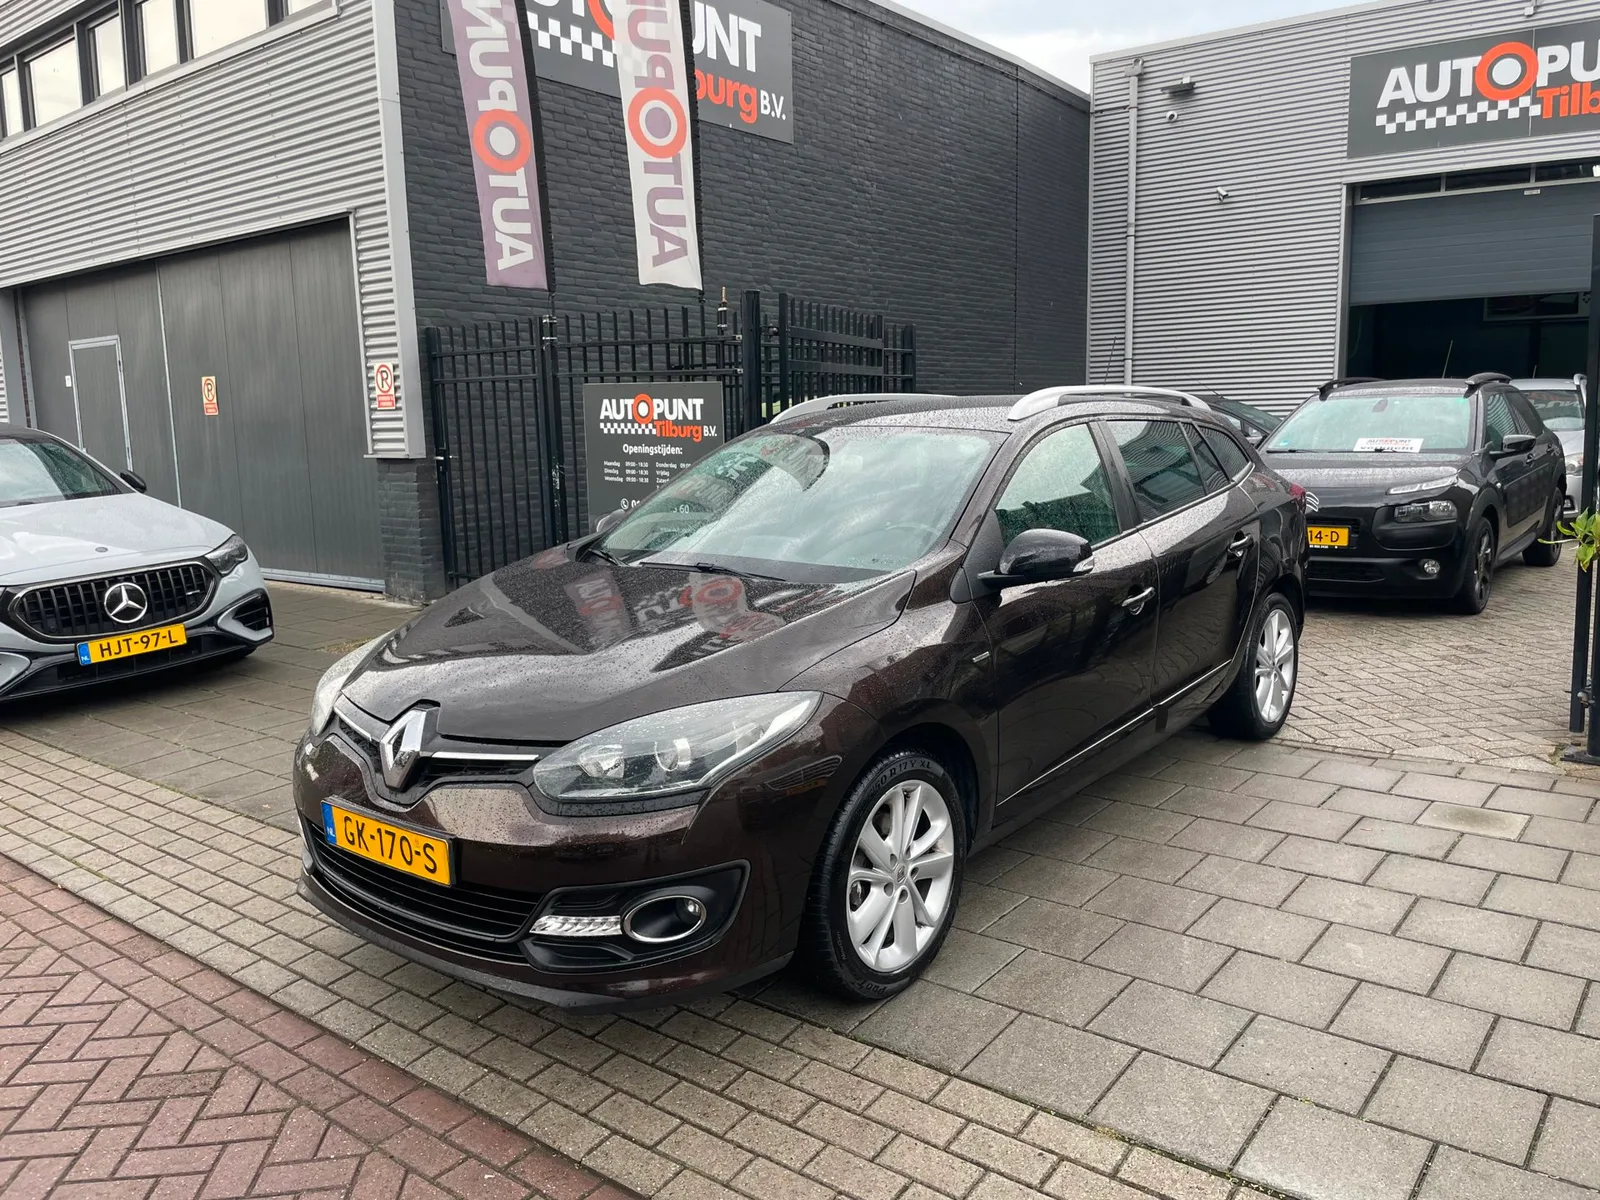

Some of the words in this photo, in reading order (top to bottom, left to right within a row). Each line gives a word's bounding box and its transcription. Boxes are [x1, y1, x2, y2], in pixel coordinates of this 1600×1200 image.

[760, 89, 787, 121] B.V.
[599, 393, 704, 424] AUTOPUNT
[654, 420, 702, 443] Tilburg
[703, 425, 718, 437] B.V.
[622, 443, 683, 456] Openingstijden:
[99, 630, 178, 658] HJT-97-L
[326, 826, 336, 837] NL
[343, 815, 438, 874] GK-170-S
